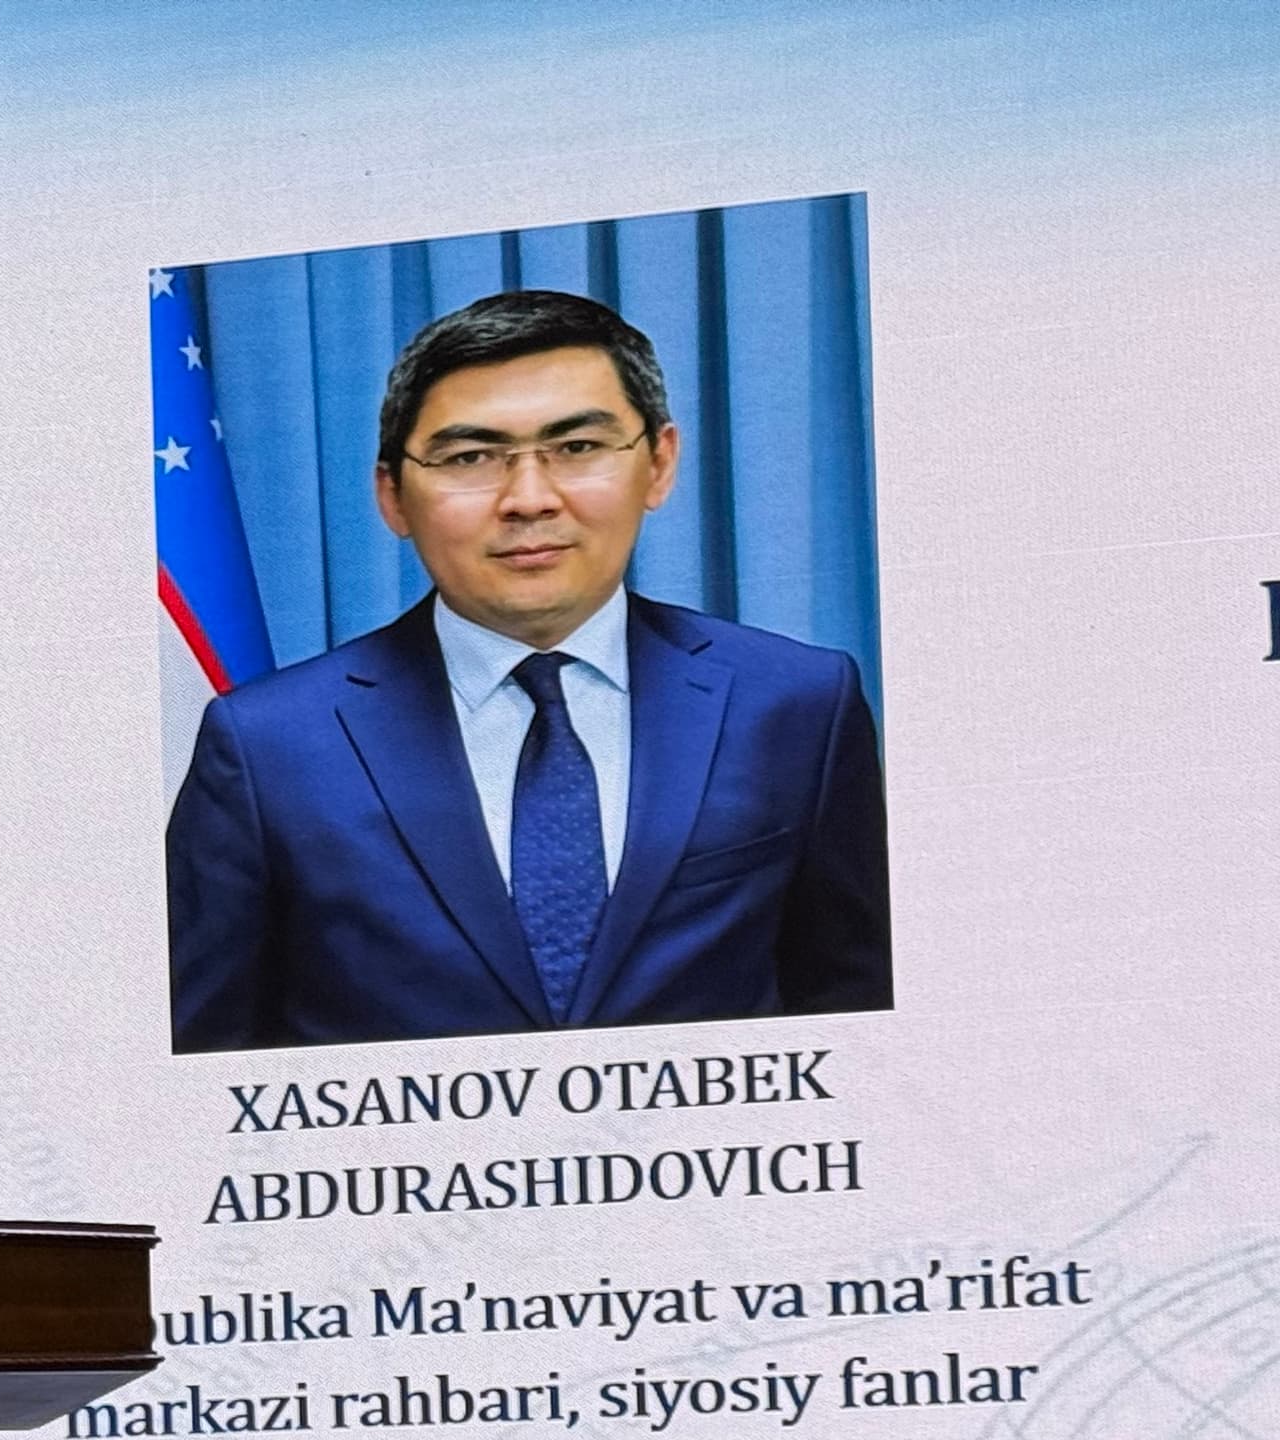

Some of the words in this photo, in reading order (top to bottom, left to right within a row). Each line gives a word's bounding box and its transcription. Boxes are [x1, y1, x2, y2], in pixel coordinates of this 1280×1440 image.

[227, 1069, 539, 1134] XASANOV
[557, 1049, 836, 1115] OTABEK
[202, 1139, 864, 1224] ABDURASHIDOVICH
[371, 1278, 717, 1341] Ma’naviyat
[731, 1284, 805, 1320] va
[826, 1256, 1093, 1315] ma’rifat
[66, 1383, 313, 1440] markazi
[331, 1372, 580, 1430] rahbari,
[599, 1364, 822, 1431] siyosiy
[838, 1353, 1039, 1409] fanlar
